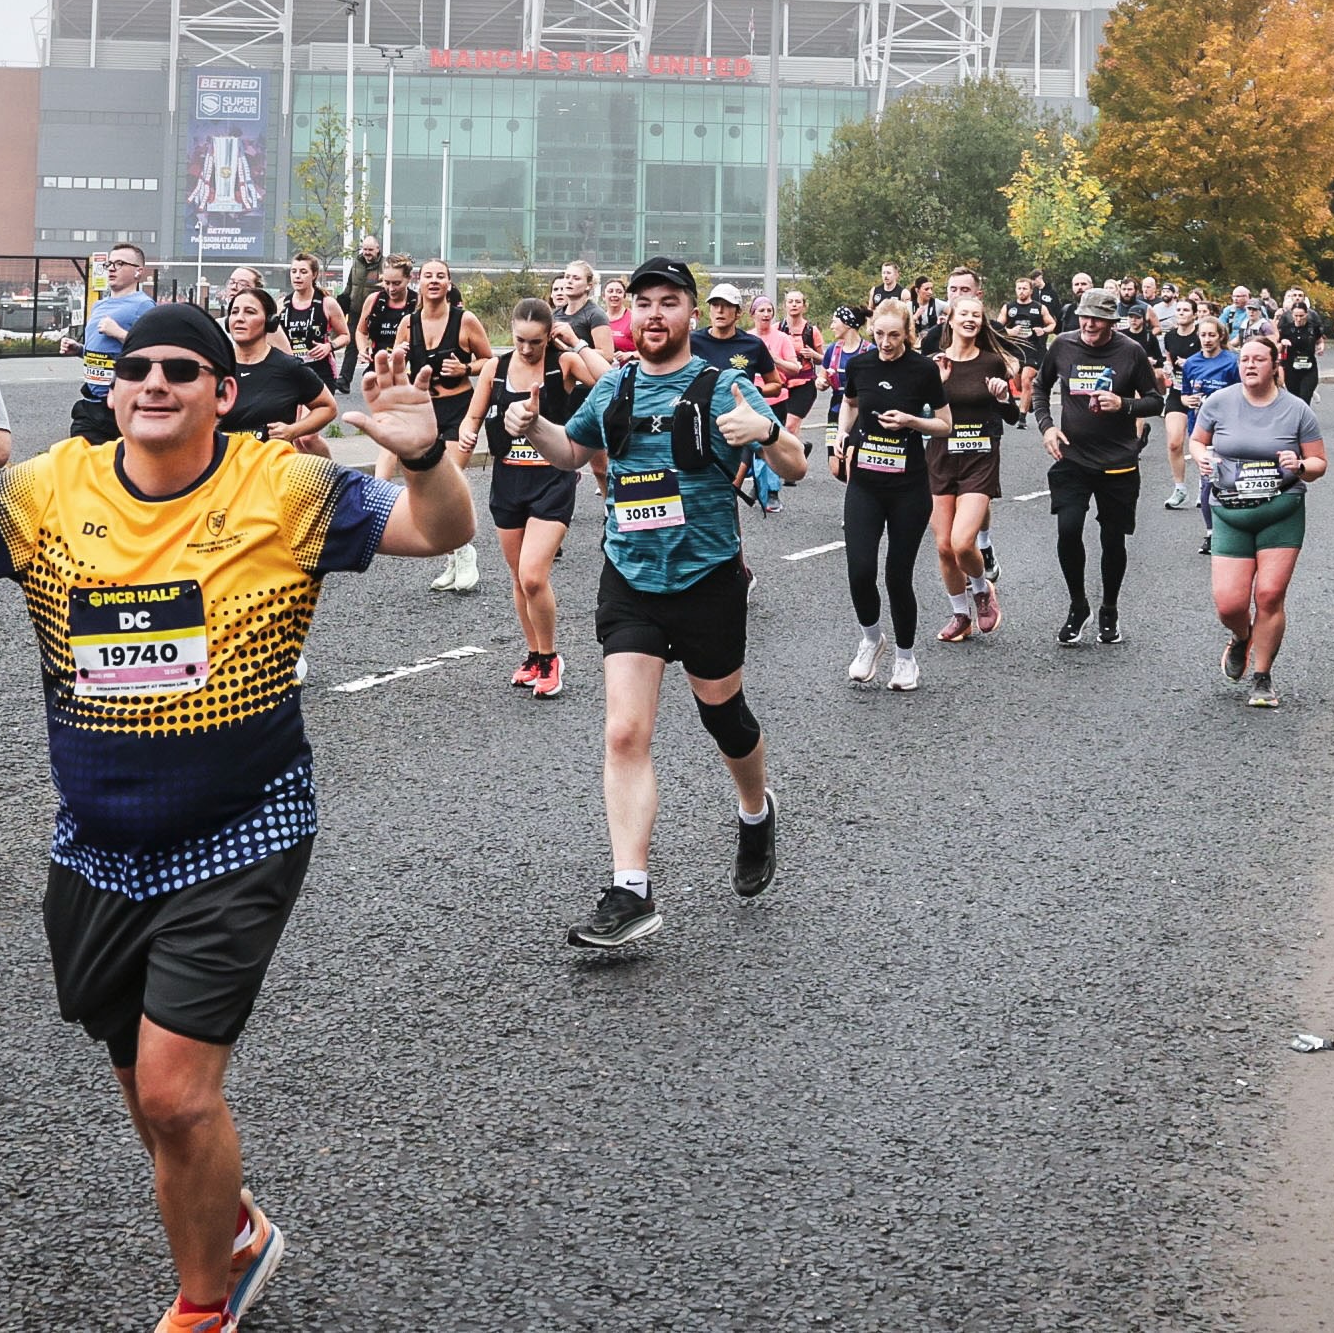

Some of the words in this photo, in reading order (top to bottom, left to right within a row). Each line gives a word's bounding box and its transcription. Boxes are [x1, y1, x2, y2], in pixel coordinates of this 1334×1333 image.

[429, 48, 628, 73] MANCHESTER
[647, 54, 752, 77] UNITED
[200, 78, 258, 89] BETFRED
[222, 96, 257, 107] SUPER
[222, 105, 257, 114] LEAGUE
[207, 227, 241, 235] BETFRED
[190, 235, 231, 243] PASIONATE
[956, 430, 981, 438] HOLLY
[510, 450, 539, 459] 21475
[866, 455, 895, 466] 21242
[627, 475, 641, 483] MCR
[641, 472, 665, 482] HALF
[1239, 468, 1280, 478] ANNABEL
[1244, 480, 1276, 489] 27408
[626, 505, 667, 521] 30813
[82, 521, 108, 539] DC
[103, 591, 136, 605] MCR
[137, 587, 181, 603] HALF
[118, 610, 151, 630] DC
[98, 643, 179, 667] 19740
